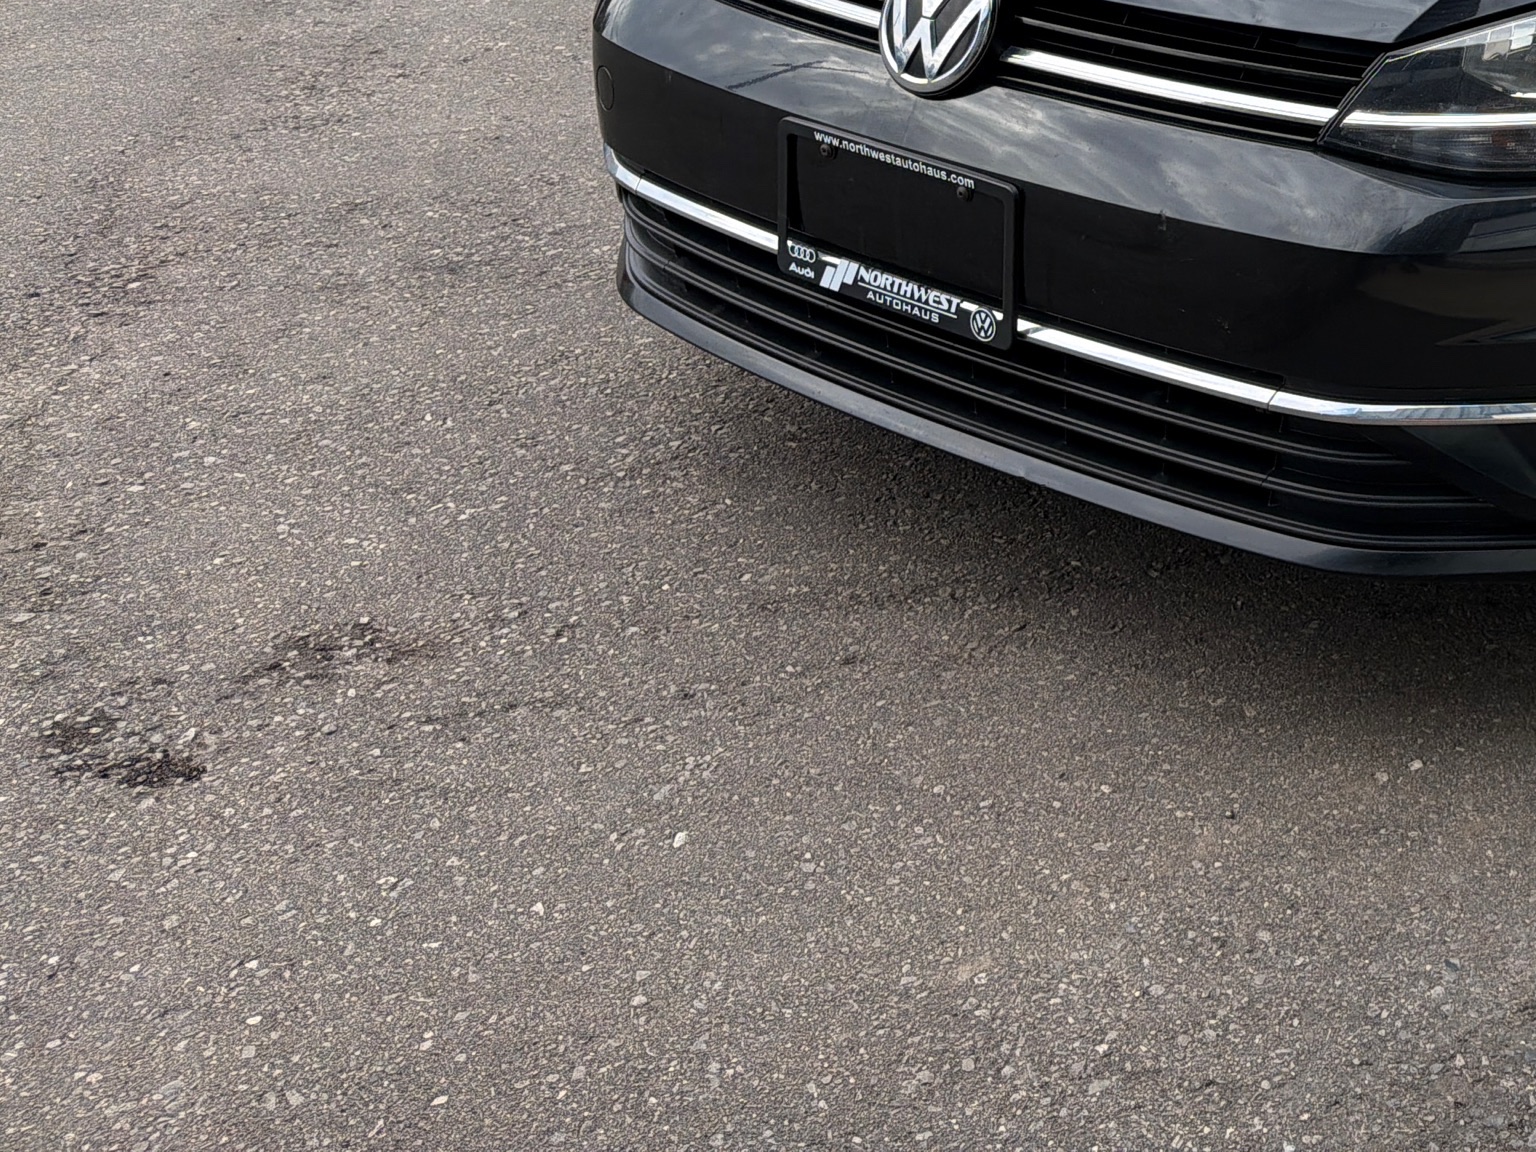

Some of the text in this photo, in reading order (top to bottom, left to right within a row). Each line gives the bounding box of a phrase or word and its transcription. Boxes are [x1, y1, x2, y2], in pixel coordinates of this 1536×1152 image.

[813, 130, 975, 190] www.northwestautohaus.com
[789, 262, 815, 279] Audi
[857, 265, 961, 314] NORTHWEST
[866, 290, 940, 324] AUTOHAUS
[970, 307, 996, 342] VW
